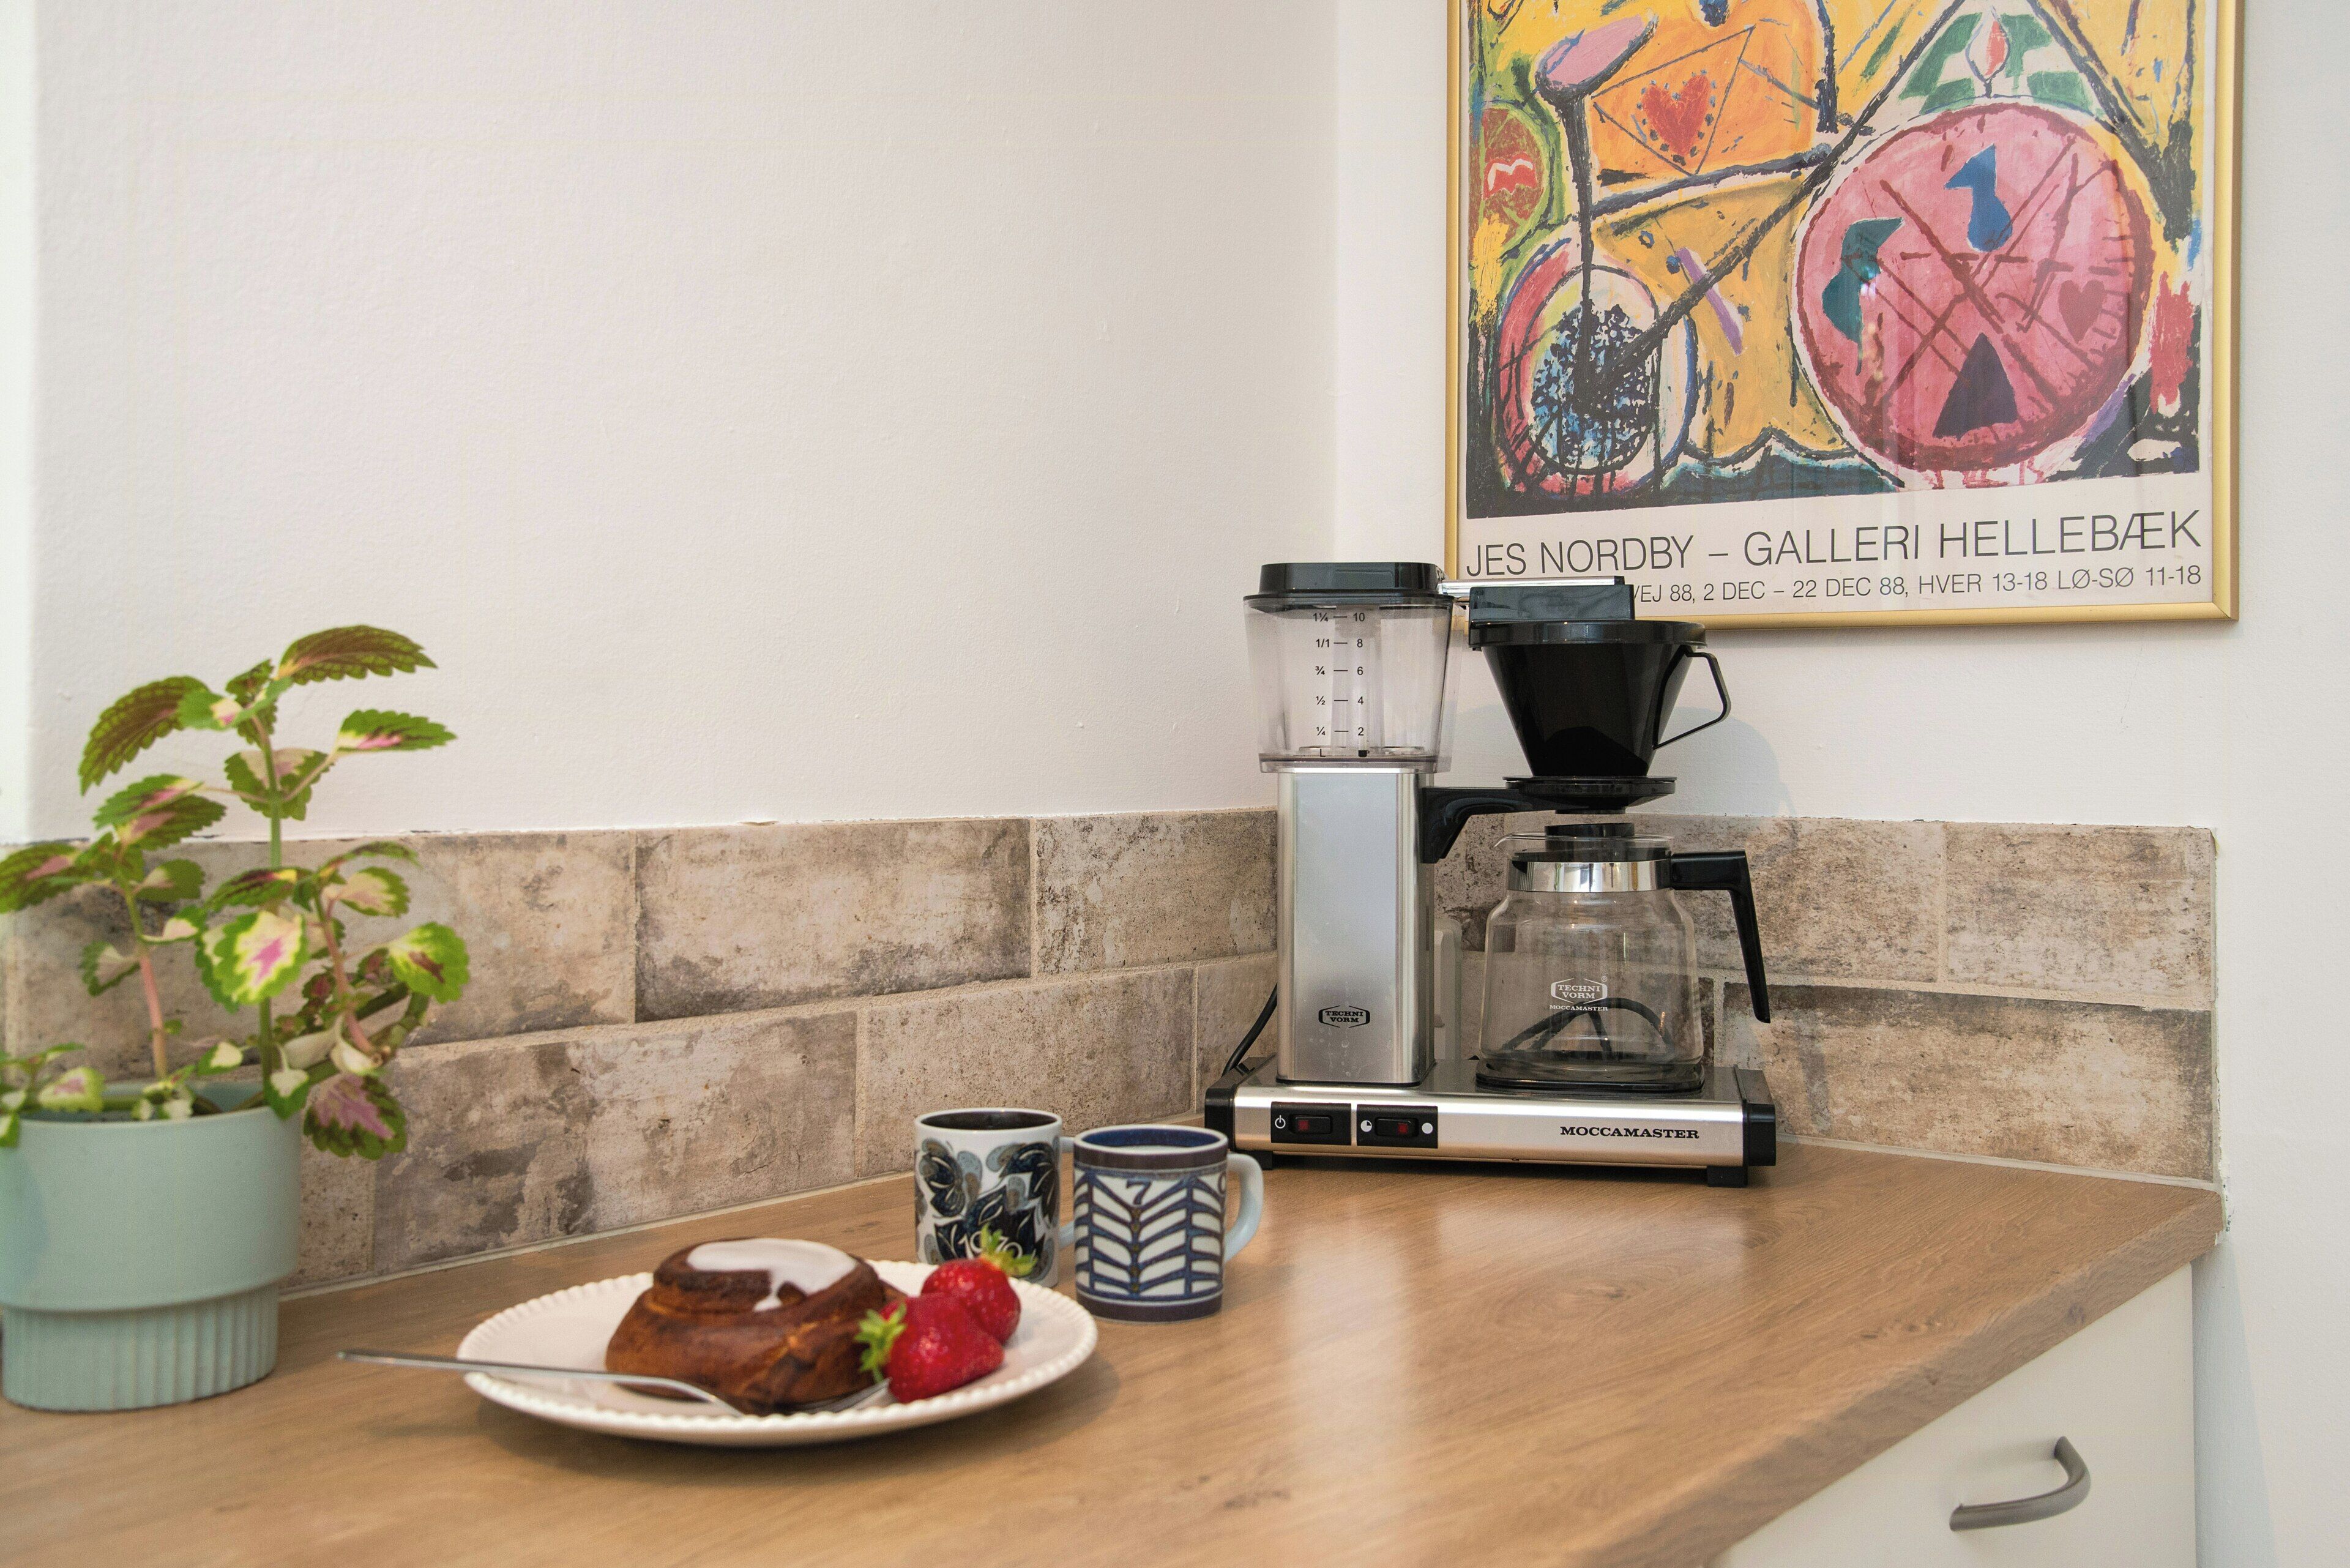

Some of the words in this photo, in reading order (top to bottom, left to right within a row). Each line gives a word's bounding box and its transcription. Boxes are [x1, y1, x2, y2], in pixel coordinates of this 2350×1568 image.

[1466, 542, 1526, 577] JES
[1540, 535, 1694, 574] NORDBY
[1744, 525, 1919, 566] GALLERI
[1939, 509, 2201, 559] HELLEBÆK
[1669, 584, 1695, 604] 88,
[1703, 583, 1714, 601] 2
[1723, 581, 1766, 600] DEC
[1792, 579, 1817, 598] 22
[1826, 577, 1871, 597] DEC
[1879, 576, 1909, 598] 88,
[1919, 573, 1982, 594] HVER
[1992, 571, 2048, 592] 13-18
[2057, 567, 2134, 589] LØ-SØ
[2145, 564, 2202, 586] 11-18
[1352, 612, 1365, 622] 10
[1315, 638, 1330, 648] 1/1
[1357, 638, 1363, 648] 8
[1357, 666, 1363, 676] 6
[1357, 696, 1364, 705] 4
[1357, 726, 1364, 736] 2
[1319, 748, 1326, 758] L
[1560, 1126, 1700, 1140] MOCCAMASTER
[1125, 1178, 1152, 1206] 7
